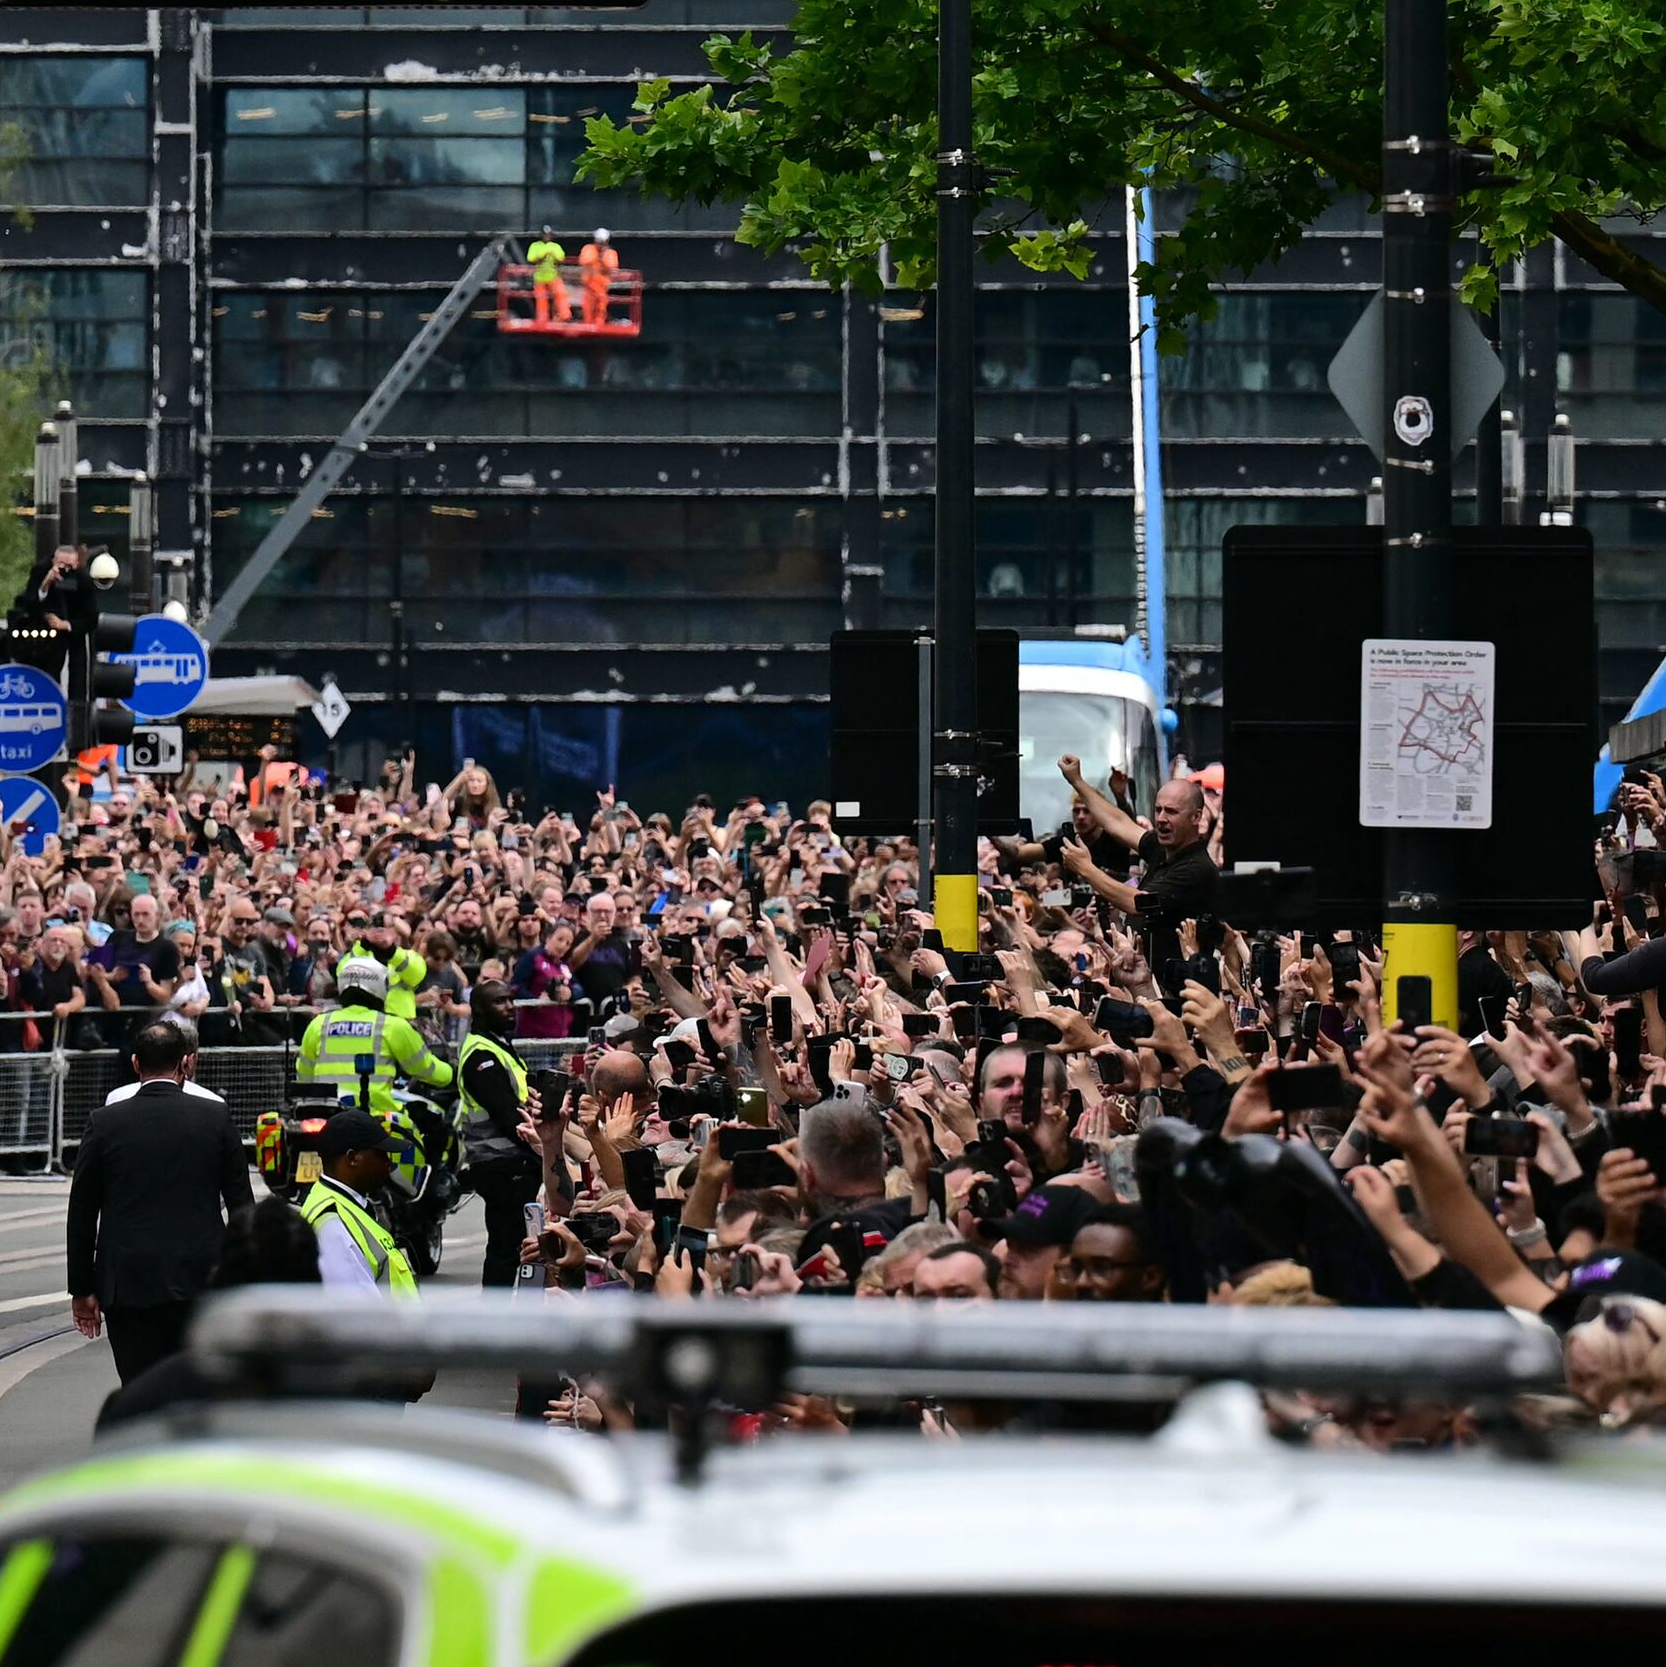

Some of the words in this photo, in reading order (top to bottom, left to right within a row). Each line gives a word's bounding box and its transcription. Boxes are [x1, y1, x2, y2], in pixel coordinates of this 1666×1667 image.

[1402, 649, 1423, 658] Space
[0, 743, 32, 760] taxi
[329, 1022, 371, 1034] POLICE
